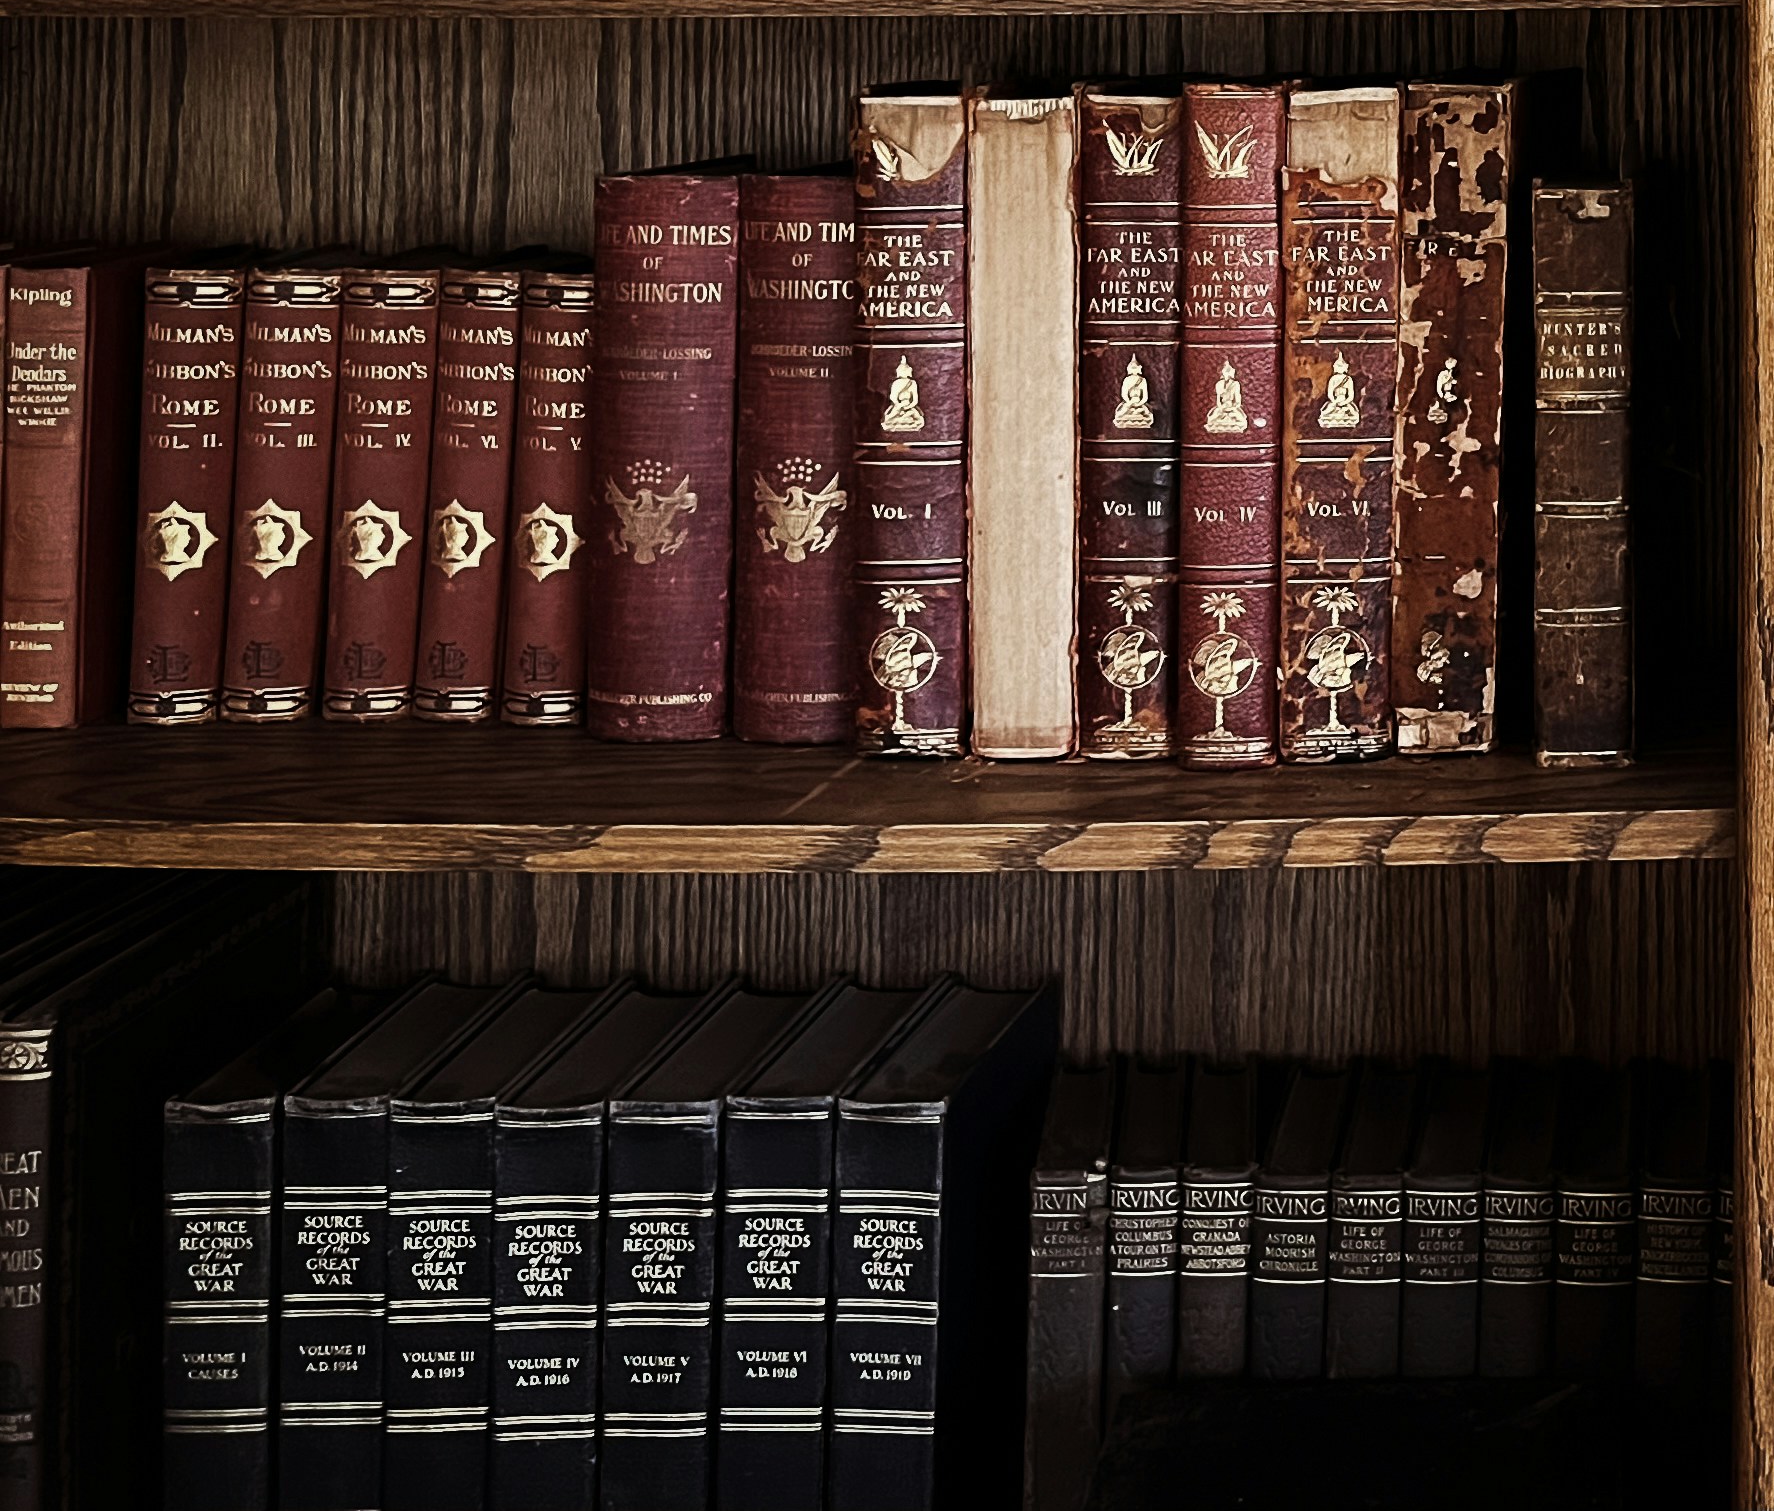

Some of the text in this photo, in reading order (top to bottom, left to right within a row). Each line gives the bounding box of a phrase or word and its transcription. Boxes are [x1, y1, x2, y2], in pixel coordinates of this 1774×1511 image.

[627, 224, 731, 246] AND TIMES
[884, 235, 922, 247] THE
[643, 257, 663, 270] OF
[899, 250, 954, 266] EAST
[884, 270, 920, 281] AND
[10, 288, 72, 307] Kipling
[868, 284, 944, 298] THE NEW
[858, 301, 953, 318] AMERICA
[1088, 297, 1179, 314] AMERICA
[49, 343, 77, 361] the
[12, 365, 66, 382] Deodars
[1540, 366, 1625, 379] BIOGRAPHY
[153, 393, 220, 416] ROME
[1240, 505, 1256, 522] IV
[1256, 1196, 1326, 1216] IRVING
[1408, 1197, 1478, 1217] IRVING
[515, 1225, 576, 1239] SOURCE
[1264, 1233, 1316, 1246] ASTORIA
[508, 1241, 582, 1256] RECORDS
[1264, 1247, 1316, 1259] MOORISH
[529, 1254, 544, 1267] of
[517, 1267, 572, 1282] GREAT
[523, 1284, 564, 1297] WAR
[508, 1357, 580, 1369] VOLUME IV
[188, 1369, 238, 1380] CAUSES
